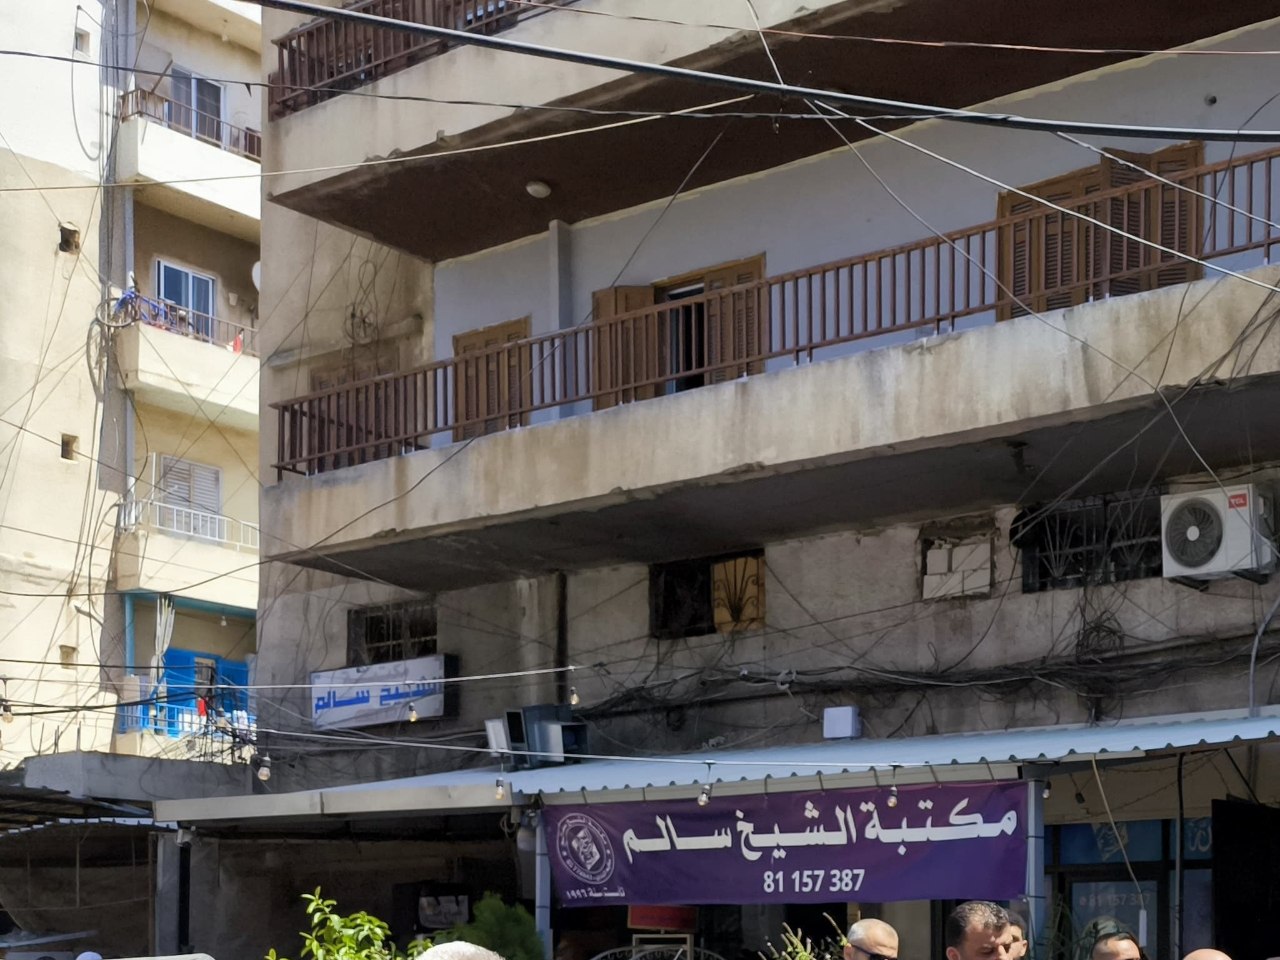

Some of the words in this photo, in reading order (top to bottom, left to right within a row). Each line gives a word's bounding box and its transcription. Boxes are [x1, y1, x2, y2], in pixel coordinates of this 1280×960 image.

[314, 688, 371, 715] سالم
[621, 814, 733, 865] سالم
[735, 800, 858, 864] الشيخ
[864, 796, 1018, 856] مكتبة
[763, 870, 785, 893] 81
[791, 869, 825, 893] 157
[829, 868, 866, 892] 387
